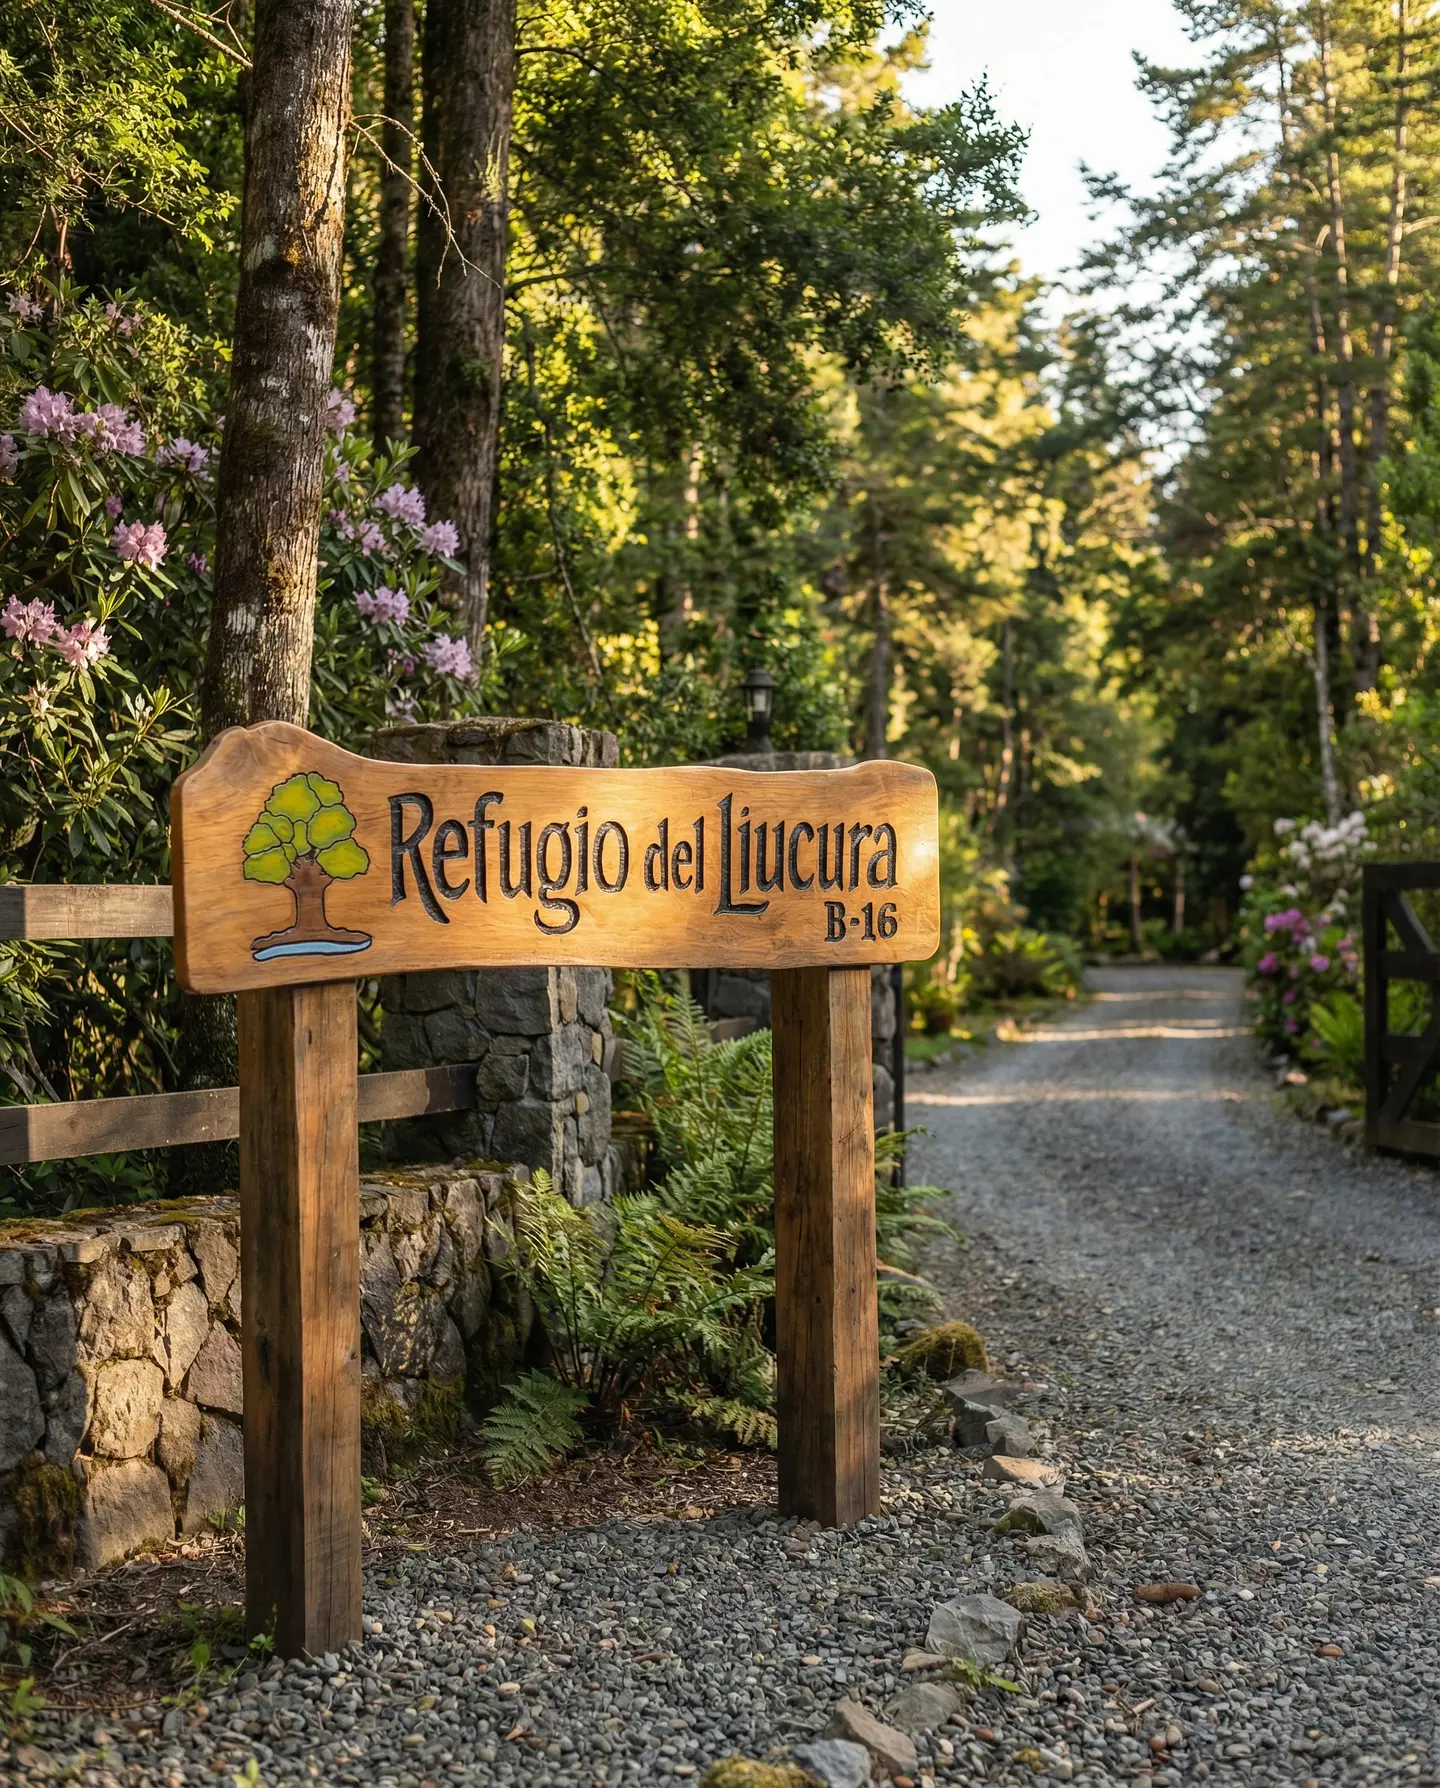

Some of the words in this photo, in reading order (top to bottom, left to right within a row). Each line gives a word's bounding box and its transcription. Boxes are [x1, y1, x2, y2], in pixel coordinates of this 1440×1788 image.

[387, 790, 630, 936] Refugio
[643, 815, 705, 895] del
[713, 791, 899, 918] Liucura
[823, 900, 899, 943] B-16
